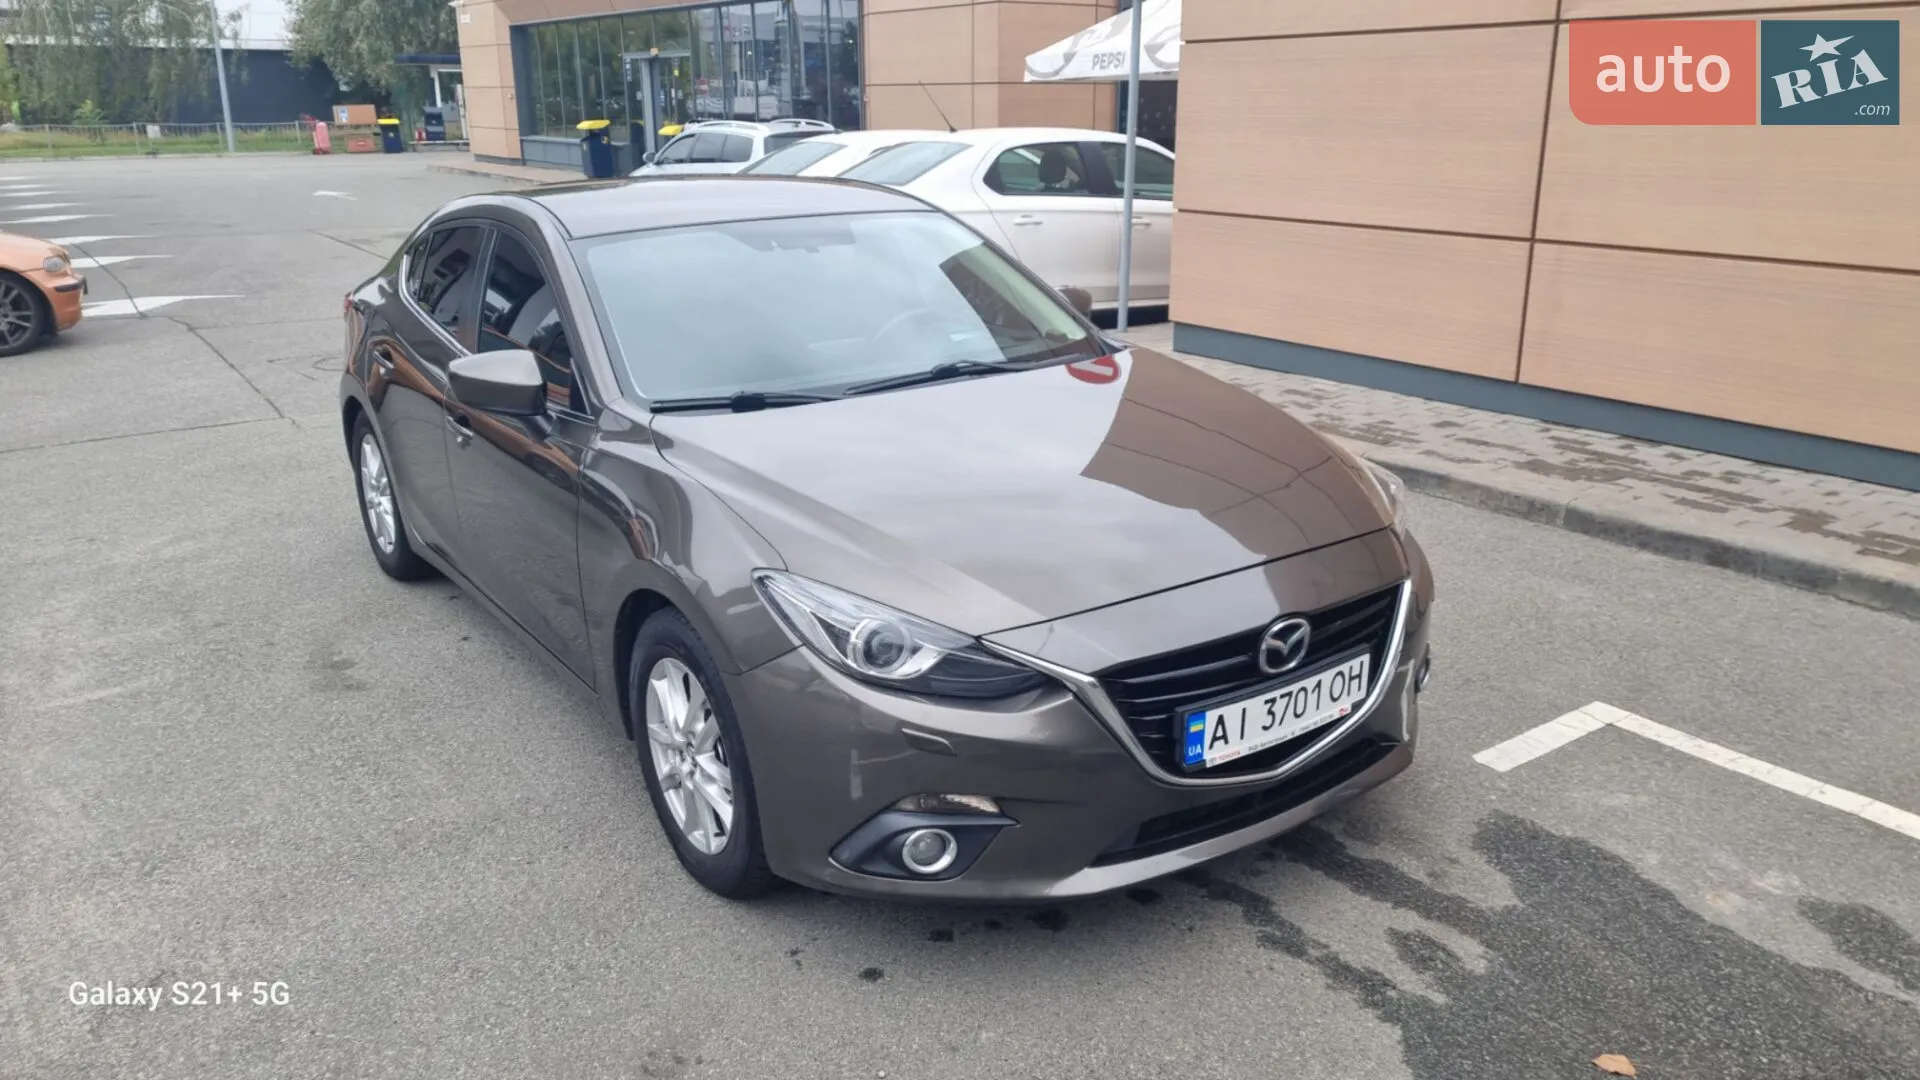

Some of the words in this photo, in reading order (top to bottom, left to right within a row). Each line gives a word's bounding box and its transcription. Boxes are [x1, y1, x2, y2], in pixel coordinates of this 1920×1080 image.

[1092, 52, 1126, 70] PEPSI
[1261, 679, 1322, 731] 3701
[1329, 660, 1364, 702] OH
[1188, 744, 1203, 757] UA
